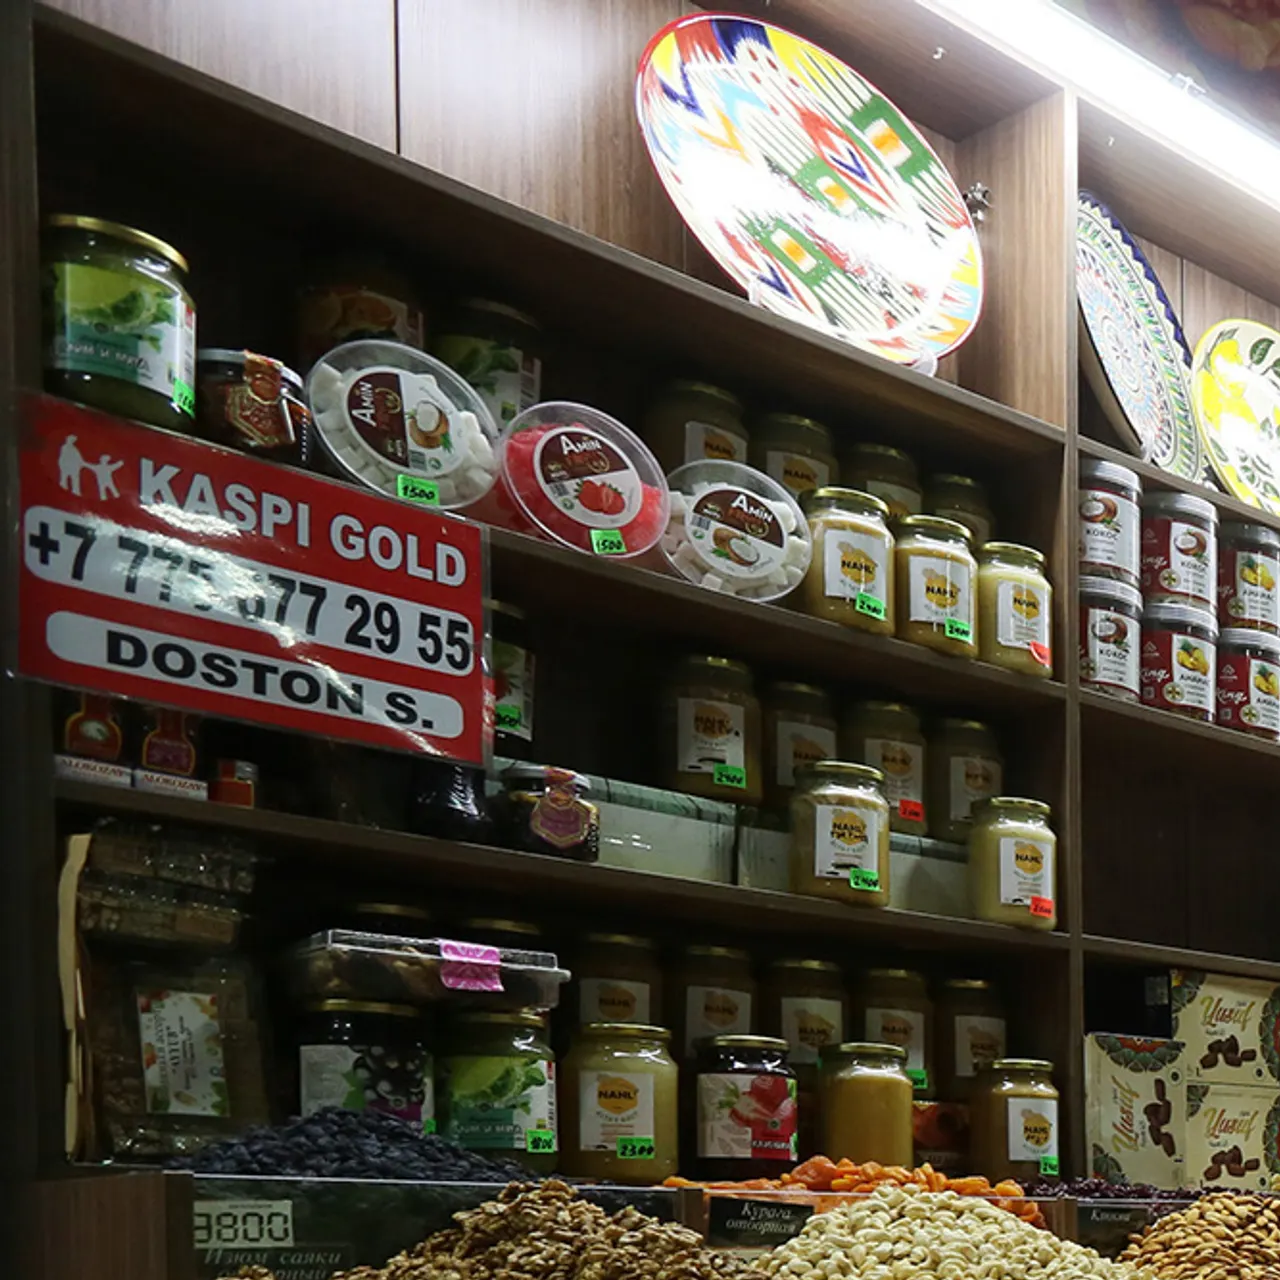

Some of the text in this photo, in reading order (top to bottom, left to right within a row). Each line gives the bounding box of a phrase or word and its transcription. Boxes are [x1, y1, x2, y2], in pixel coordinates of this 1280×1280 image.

[402, 484, 435, 500] 1500
[138, 457, 468, 588] KASPI GOLD
[596, 537, 623, 552] 1500
[29, 520, 98, 581] +7
[345, 594, 401, 654] 29
[418, 611, 471, 671] 55
[106, 629, 434, 729] DOSTON S.
[1200, 996, 1255, 1032] Yusuf
[598, 1090, 636, 1101] NAHL
[1205, 1107, 1259, 1142] Yusuf
[740, 1201, 793, 1221] Курага
[204, 1248, 268, 1266] Изюм
